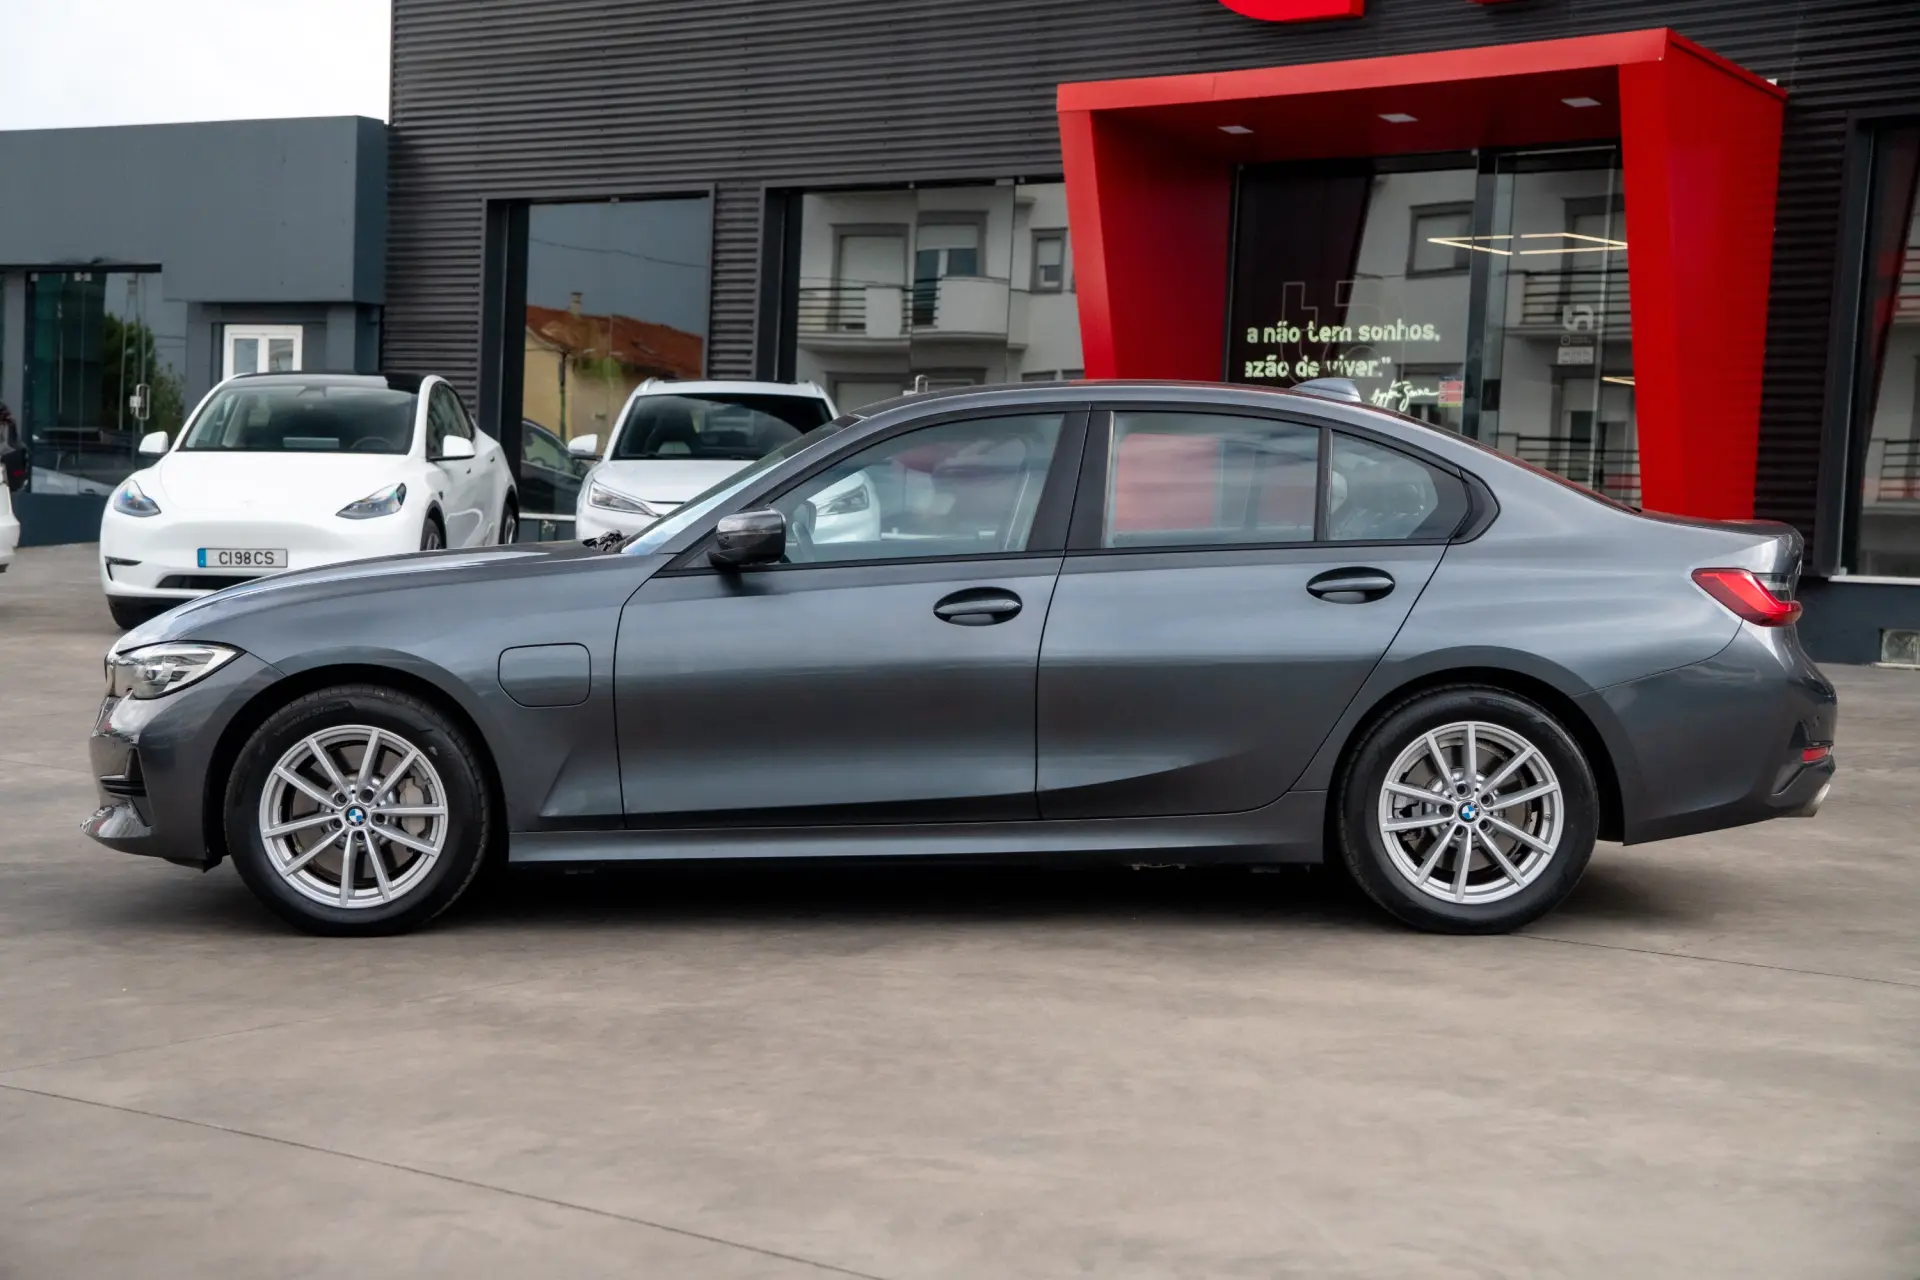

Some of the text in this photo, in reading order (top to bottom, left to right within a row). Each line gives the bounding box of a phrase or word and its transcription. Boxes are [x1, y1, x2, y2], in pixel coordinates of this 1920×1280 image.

[1263, 320, 1300, 343] não
[1307, 320, 1352, 343] tem
[1295, 354, 1320, 378] de
